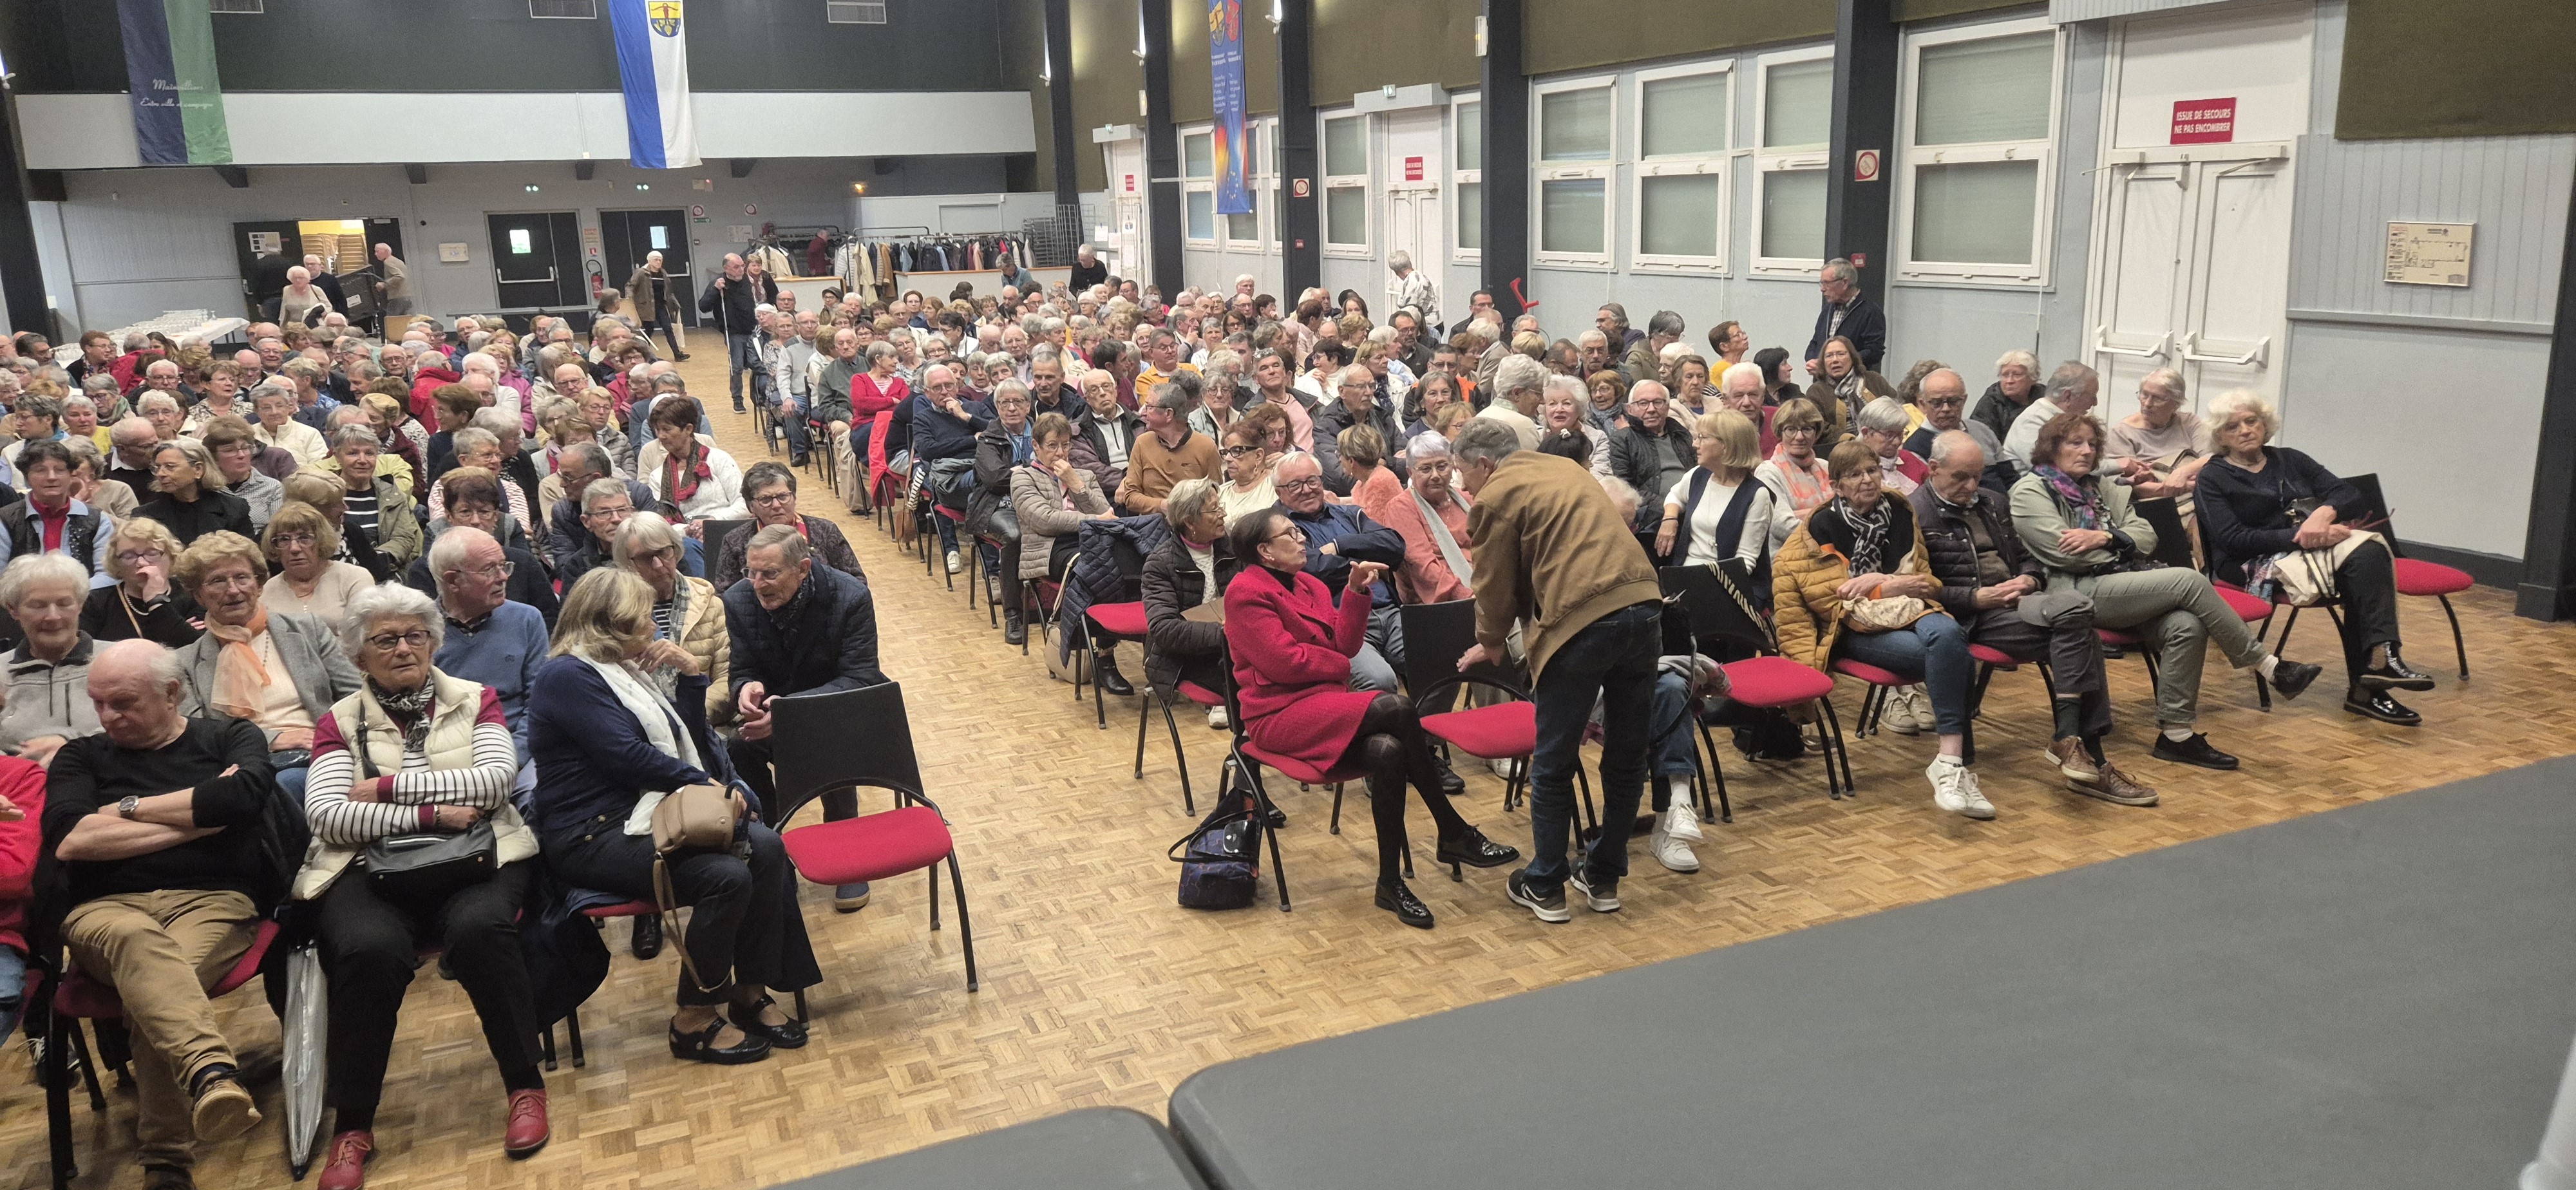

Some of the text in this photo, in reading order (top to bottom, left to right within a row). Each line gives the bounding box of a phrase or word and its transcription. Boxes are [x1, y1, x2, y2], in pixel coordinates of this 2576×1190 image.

[2176, 108, 2231, 121] ISSUE DE SECOURS
[2174, 122, 2231, 134] NE PAS ENCOMBRER
